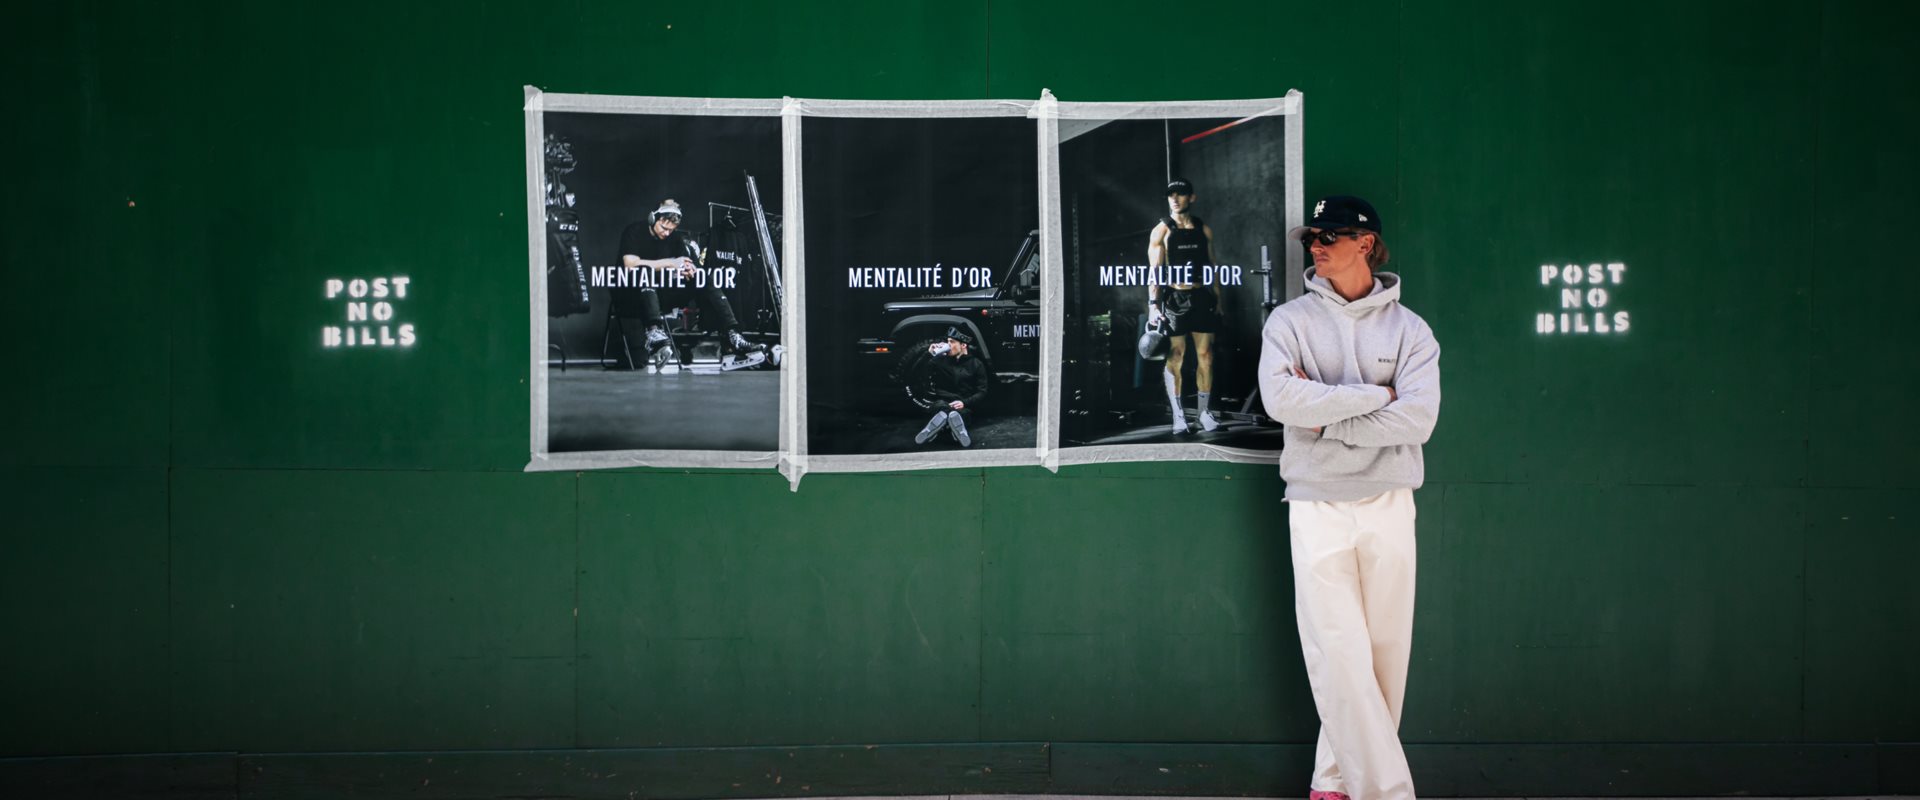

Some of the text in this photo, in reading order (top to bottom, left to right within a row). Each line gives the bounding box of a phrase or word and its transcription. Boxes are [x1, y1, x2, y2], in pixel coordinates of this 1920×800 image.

[696, 267, 736, 289] D'OR
[848, 263, 992, 288] MENTALITÉ D'OR
[1099, 261, 1242, 286] MENTALITÉ D'OR
[1540, 262, 1626, 286] POST
[326, 276, 410, 299] POST
[1561, 287, 1608, 309] NO
[347, 301, 393, 322] NO
[1536, 311, 1630, 334] BILLS
[322, 323, 417, 347] BILLS
